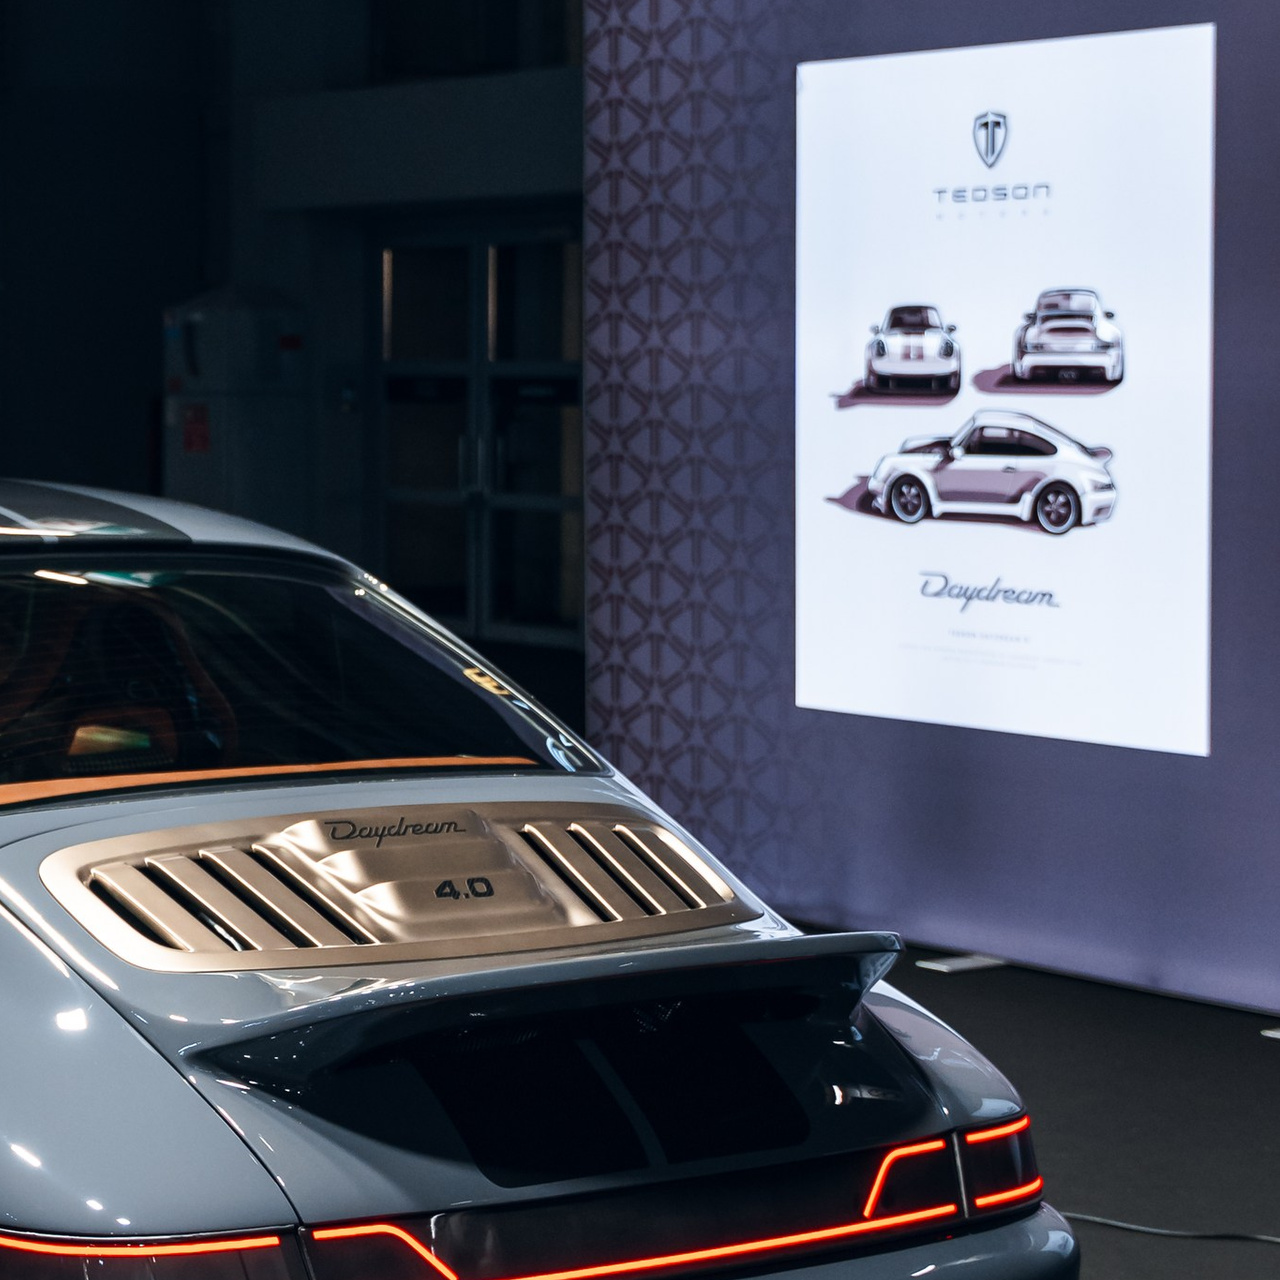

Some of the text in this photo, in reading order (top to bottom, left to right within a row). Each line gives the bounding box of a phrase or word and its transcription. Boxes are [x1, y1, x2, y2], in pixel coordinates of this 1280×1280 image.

[933, 182, 1050, 203] TEDSON
[919, 571, 1061, 613] Daydream
[324, 817, 466, 848] Daydream
[434, 877, 495, 899] 4.0
